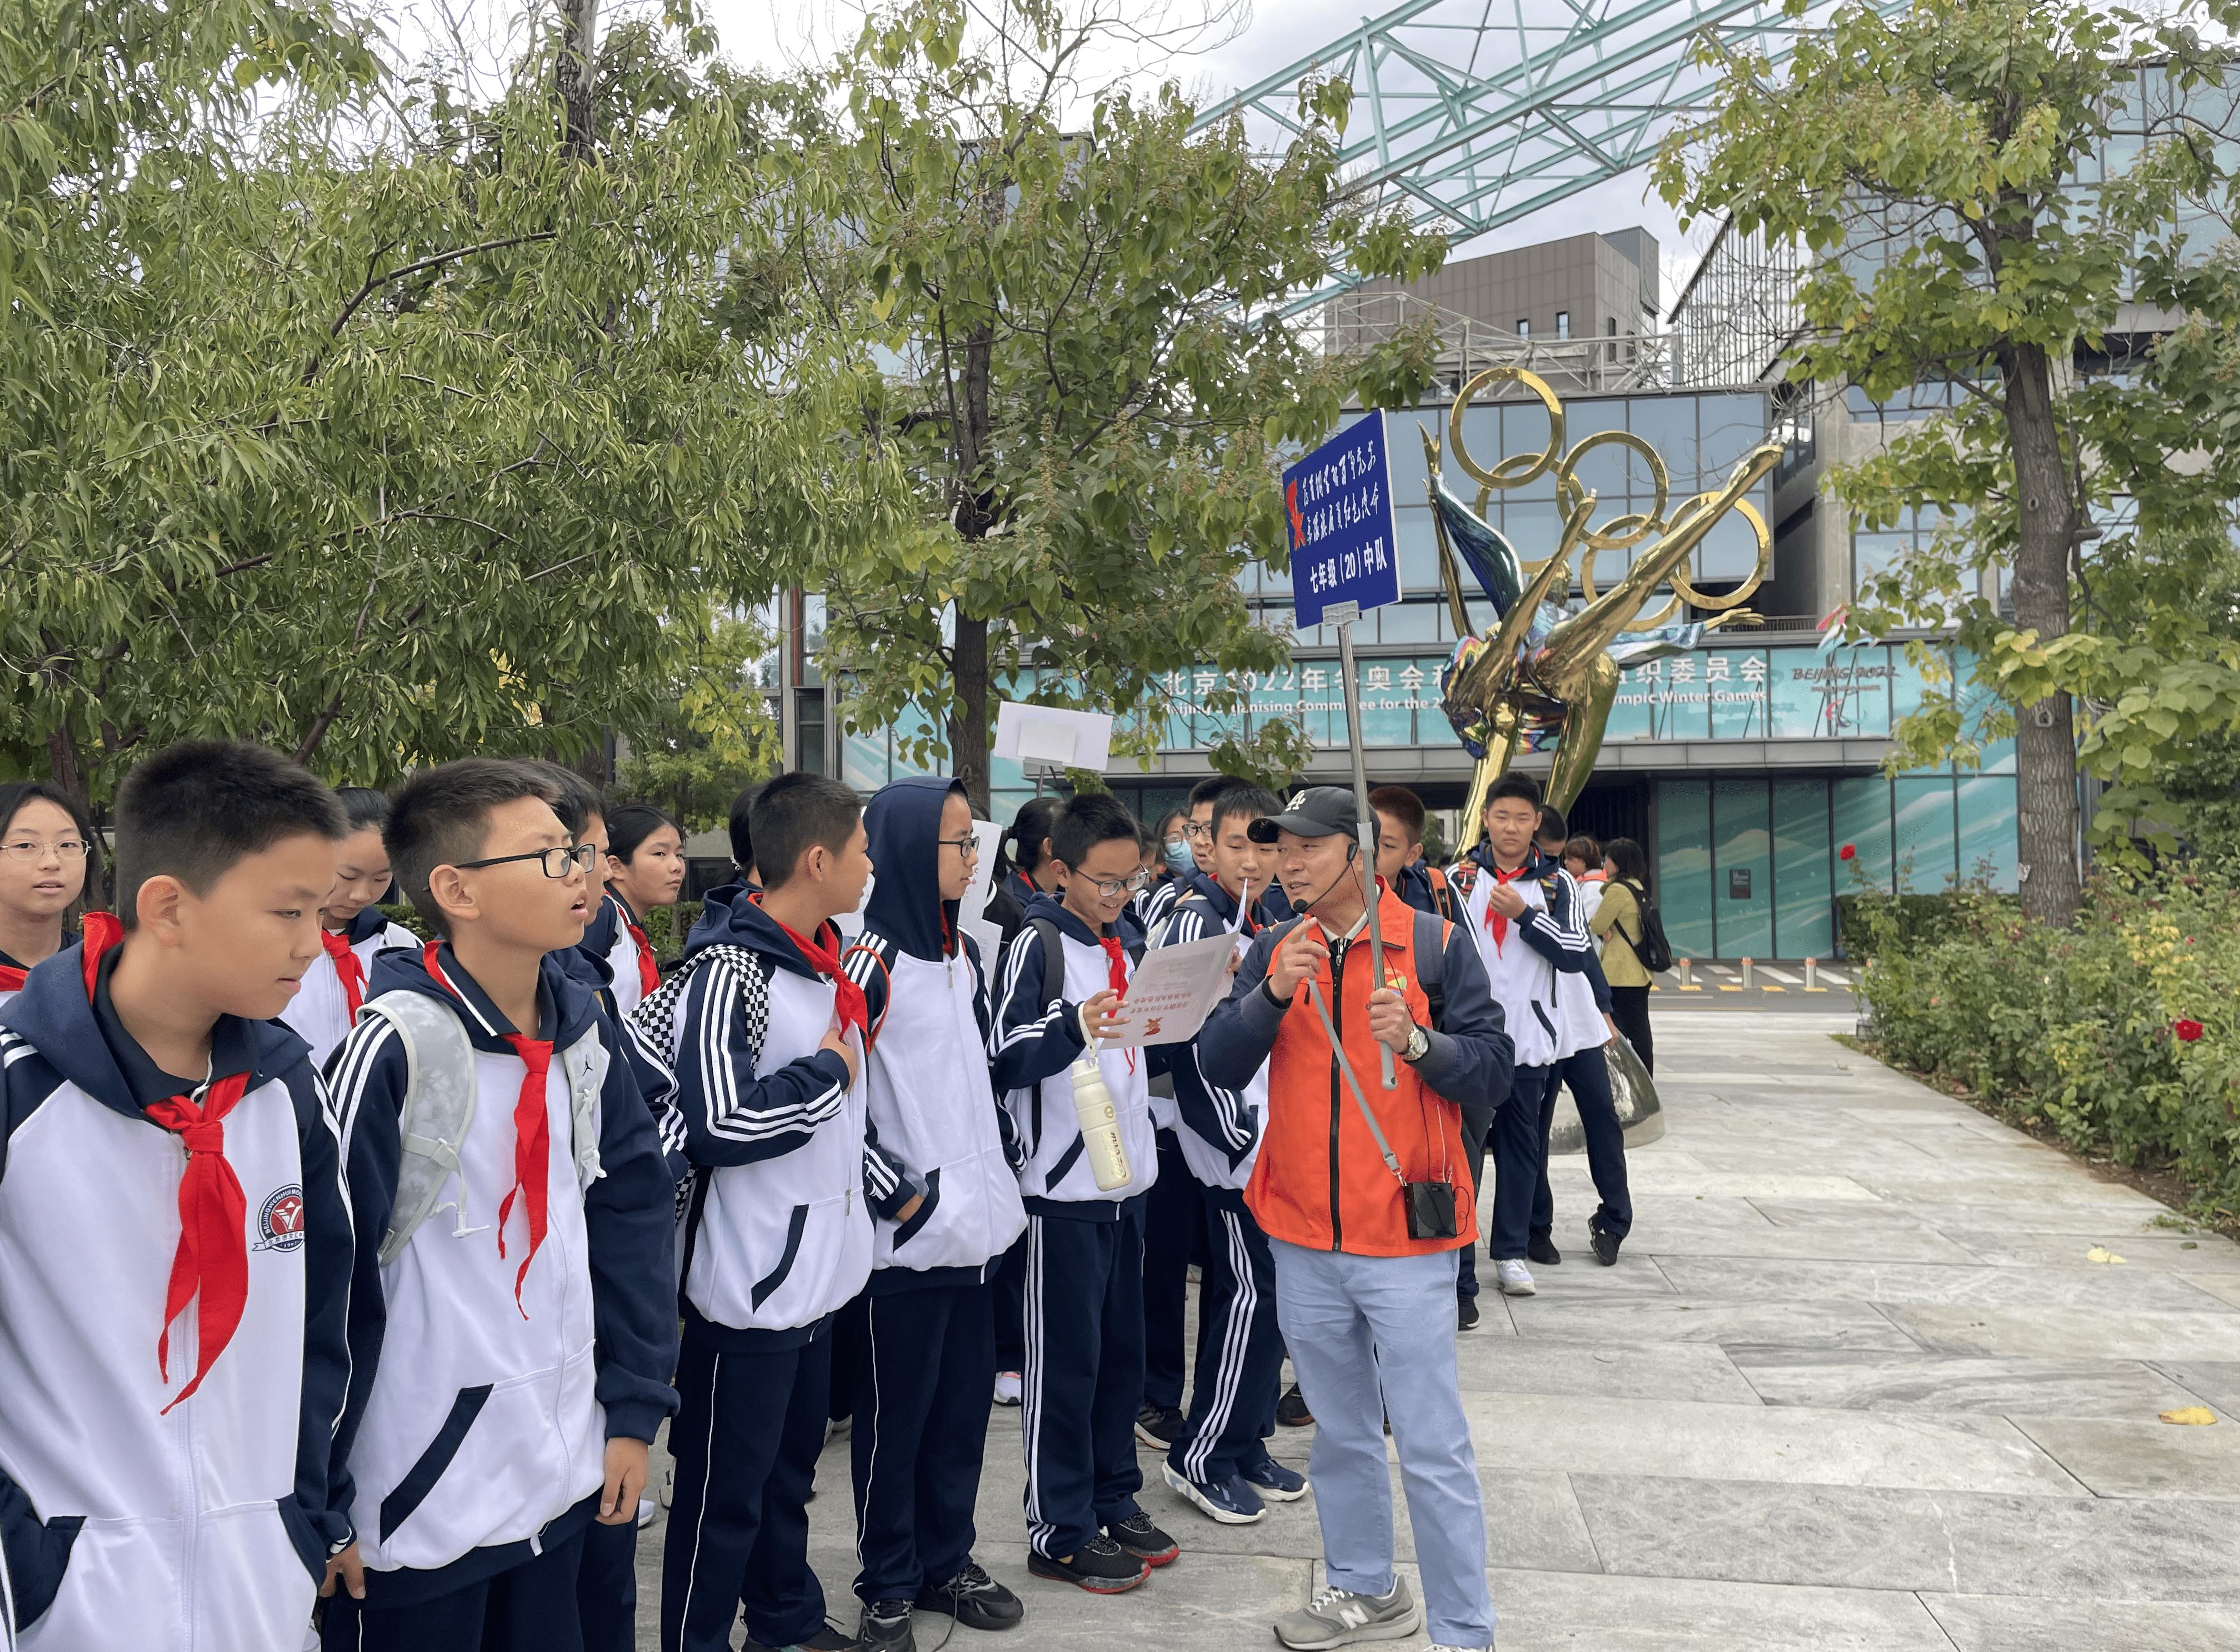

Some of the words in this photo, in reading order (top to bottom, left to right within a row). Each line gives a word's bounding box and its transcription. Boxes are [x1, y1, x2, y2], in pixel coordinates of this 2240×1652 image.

[1309, 536, 1387, 594] 七年级（20）中队
[1619, 655, 1767, 684] 织委员会
[1792, 667, 1851, 684] BEIJING
[1216, 699, 1292, 715] ganising
[1297, 699, 1376, 712] Commiee
[1380, 697, 1401, 710] for
[1404, 697, 1428, 710] the
[1658, 690, 1710, 704] Winter
[1714, 689, 1767, 704] Games
[268, 1232, 304, 1245] 北京市文汇中
[1339, 1604, 1369, 1630] N
